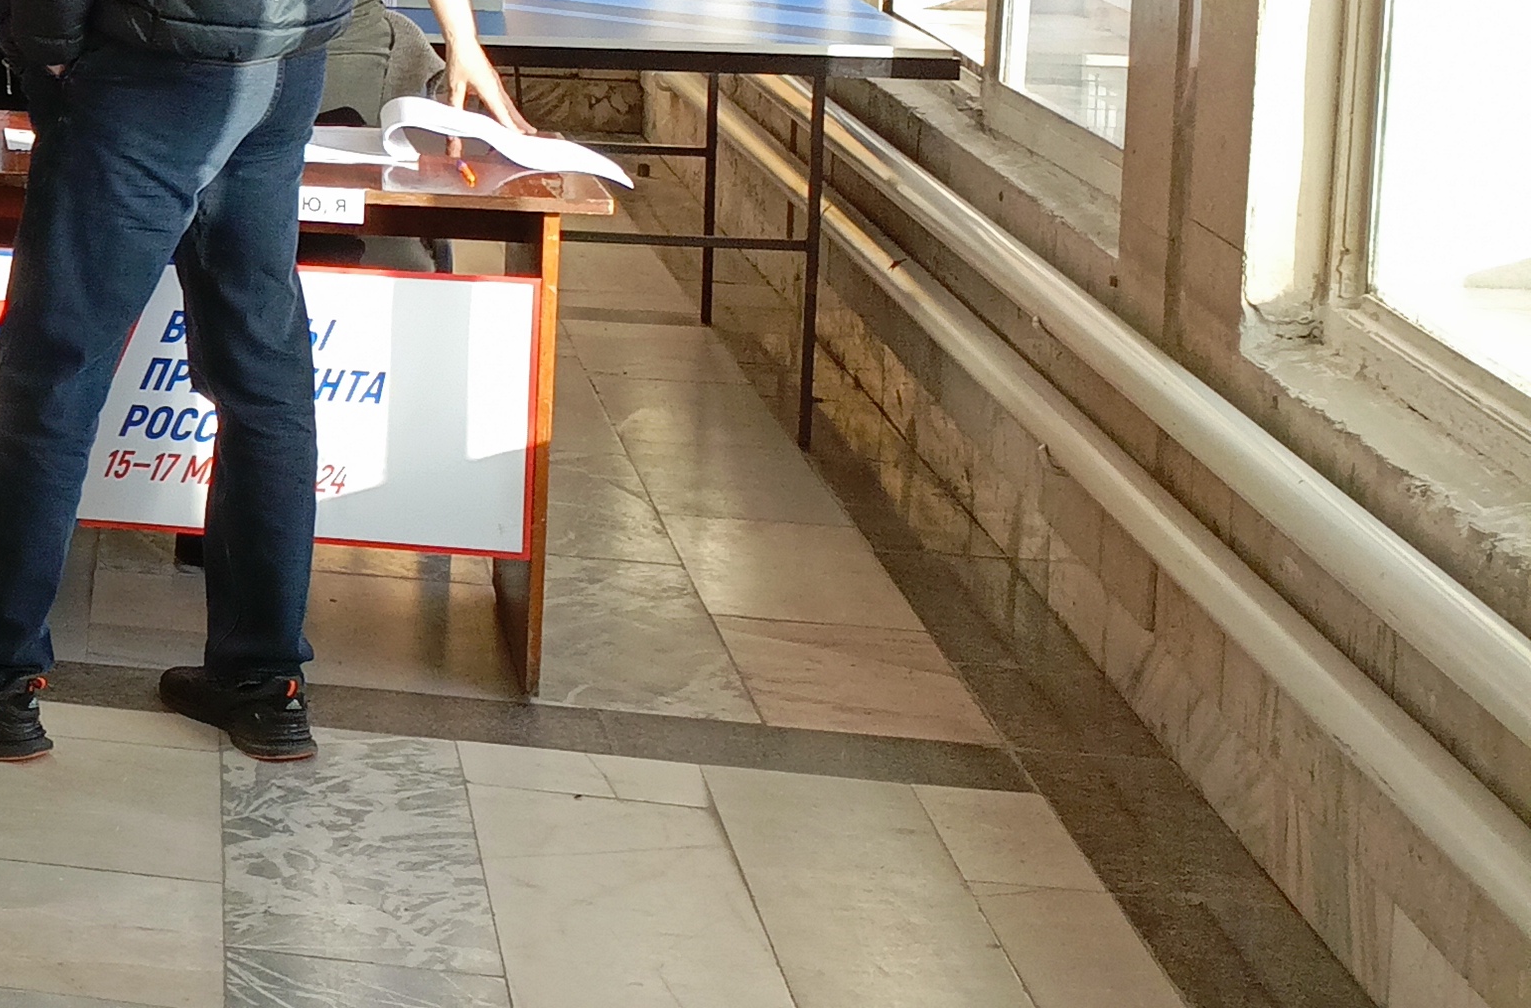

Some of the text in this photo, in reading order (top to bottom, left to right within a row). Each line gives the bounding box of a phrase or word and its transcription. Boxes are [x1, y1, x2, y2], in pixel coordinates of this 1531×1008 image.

[302, 196, 347, 215] Ю, Я
[118, 404, 218, 442] РОСС
